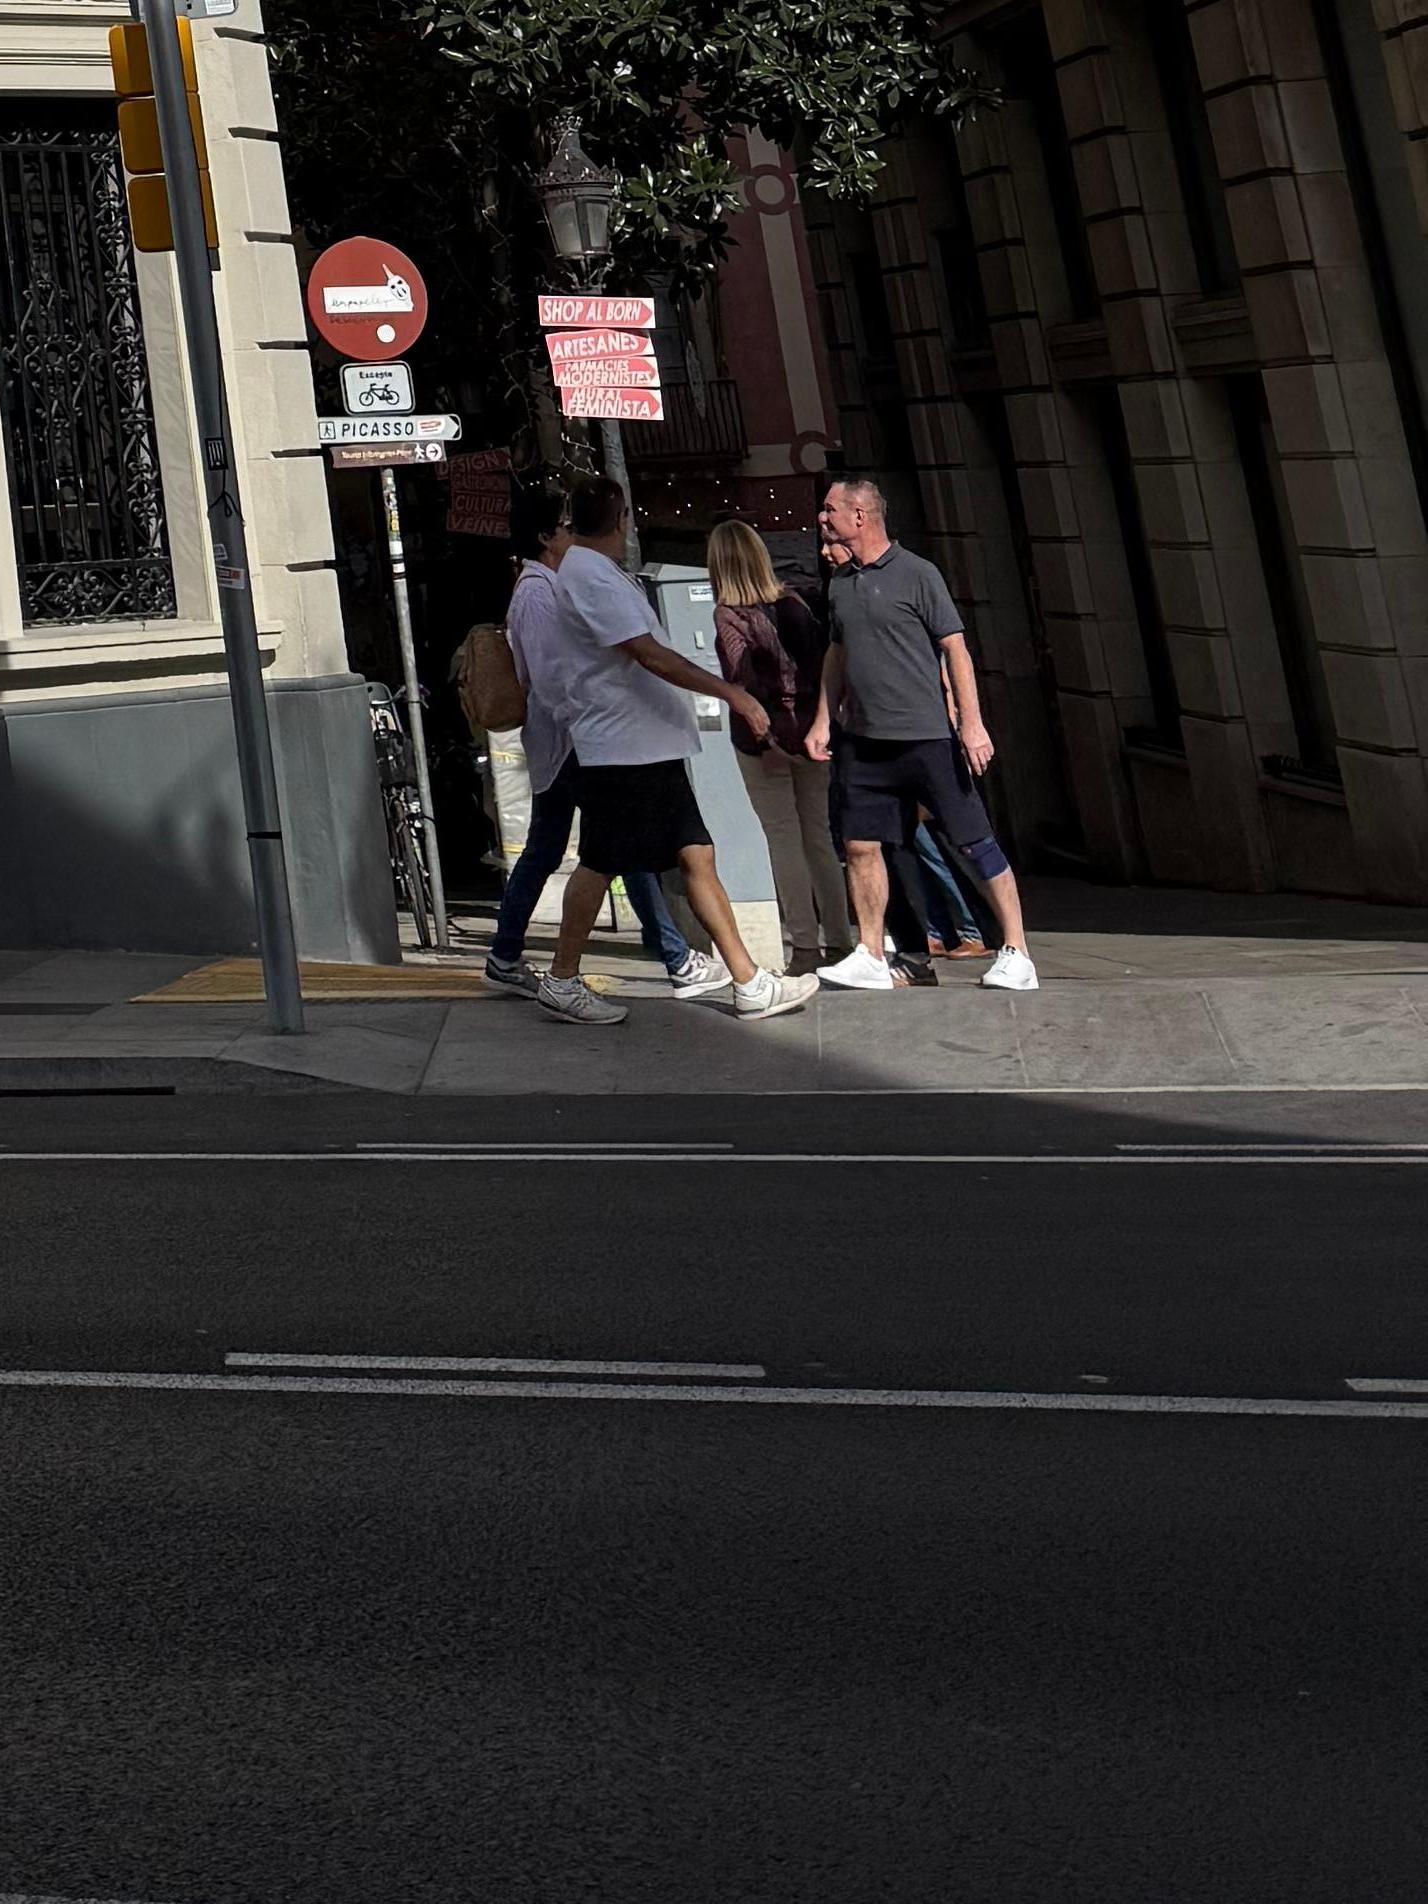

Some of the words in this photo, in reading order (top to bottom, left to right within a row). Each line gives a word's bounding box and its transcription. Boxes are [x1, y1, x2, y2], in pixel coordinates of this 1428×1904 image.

[543, 299, 585, 322] SHOP
[586, 300, 603, 321] AL
[605, 300, 642, 321] BORN
[552, 333, 638, 360] ARTESANES
[557, 371, 652, 386] MODERNISTES
[341, 421, 414, 437] PICASSO
